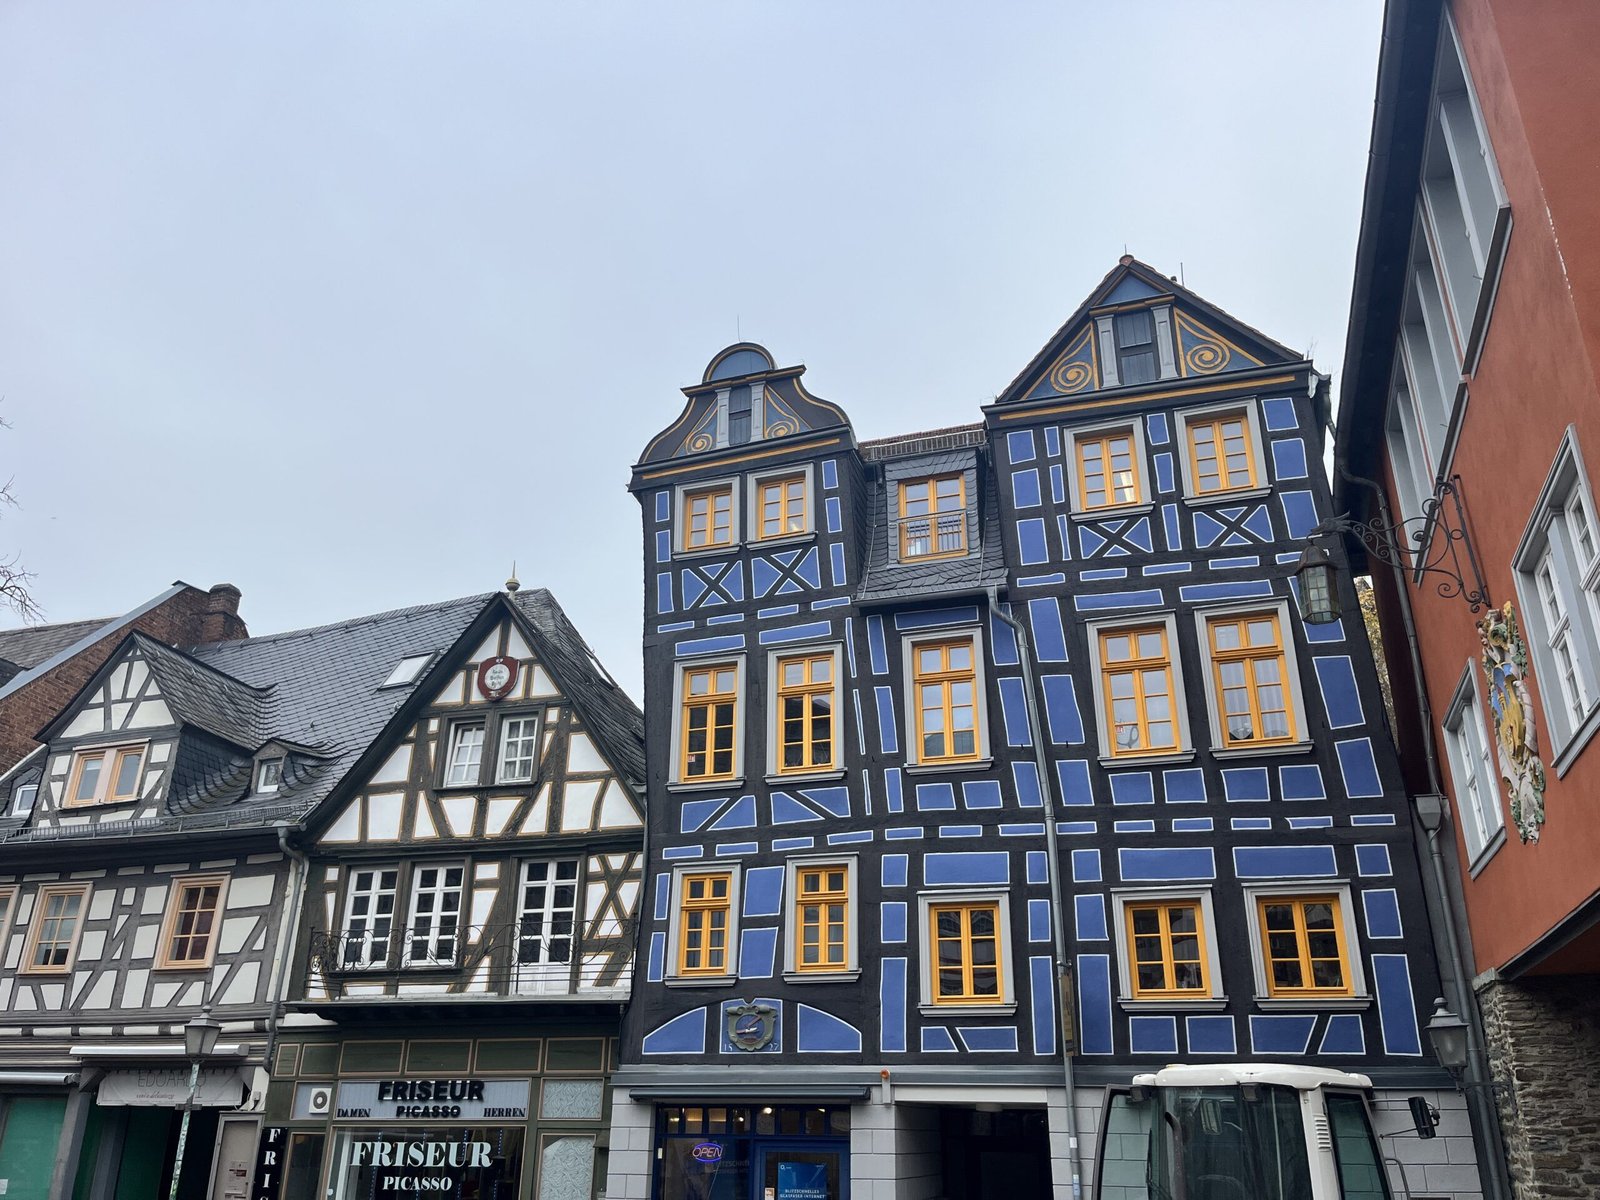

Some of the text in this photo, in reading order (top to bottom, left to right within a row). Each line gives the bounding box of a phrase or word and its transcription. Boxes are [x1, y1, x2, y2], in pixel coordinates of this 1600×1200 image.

[137, 1070, 207, 1088] EDOARO
[377, 1080, 485, 1101] FRISEUR
[337, 1108, 371, 1118] DAMEN
[395, 1105, 461, 1118] PICASSO
[483, 1107, 526, 1118] HERREN
[350, 1141, 494, 1168] FRISEUR
[692, 1146, 723, 1158] OPEN
[382, 1176, 453, 1191] PICASSO
